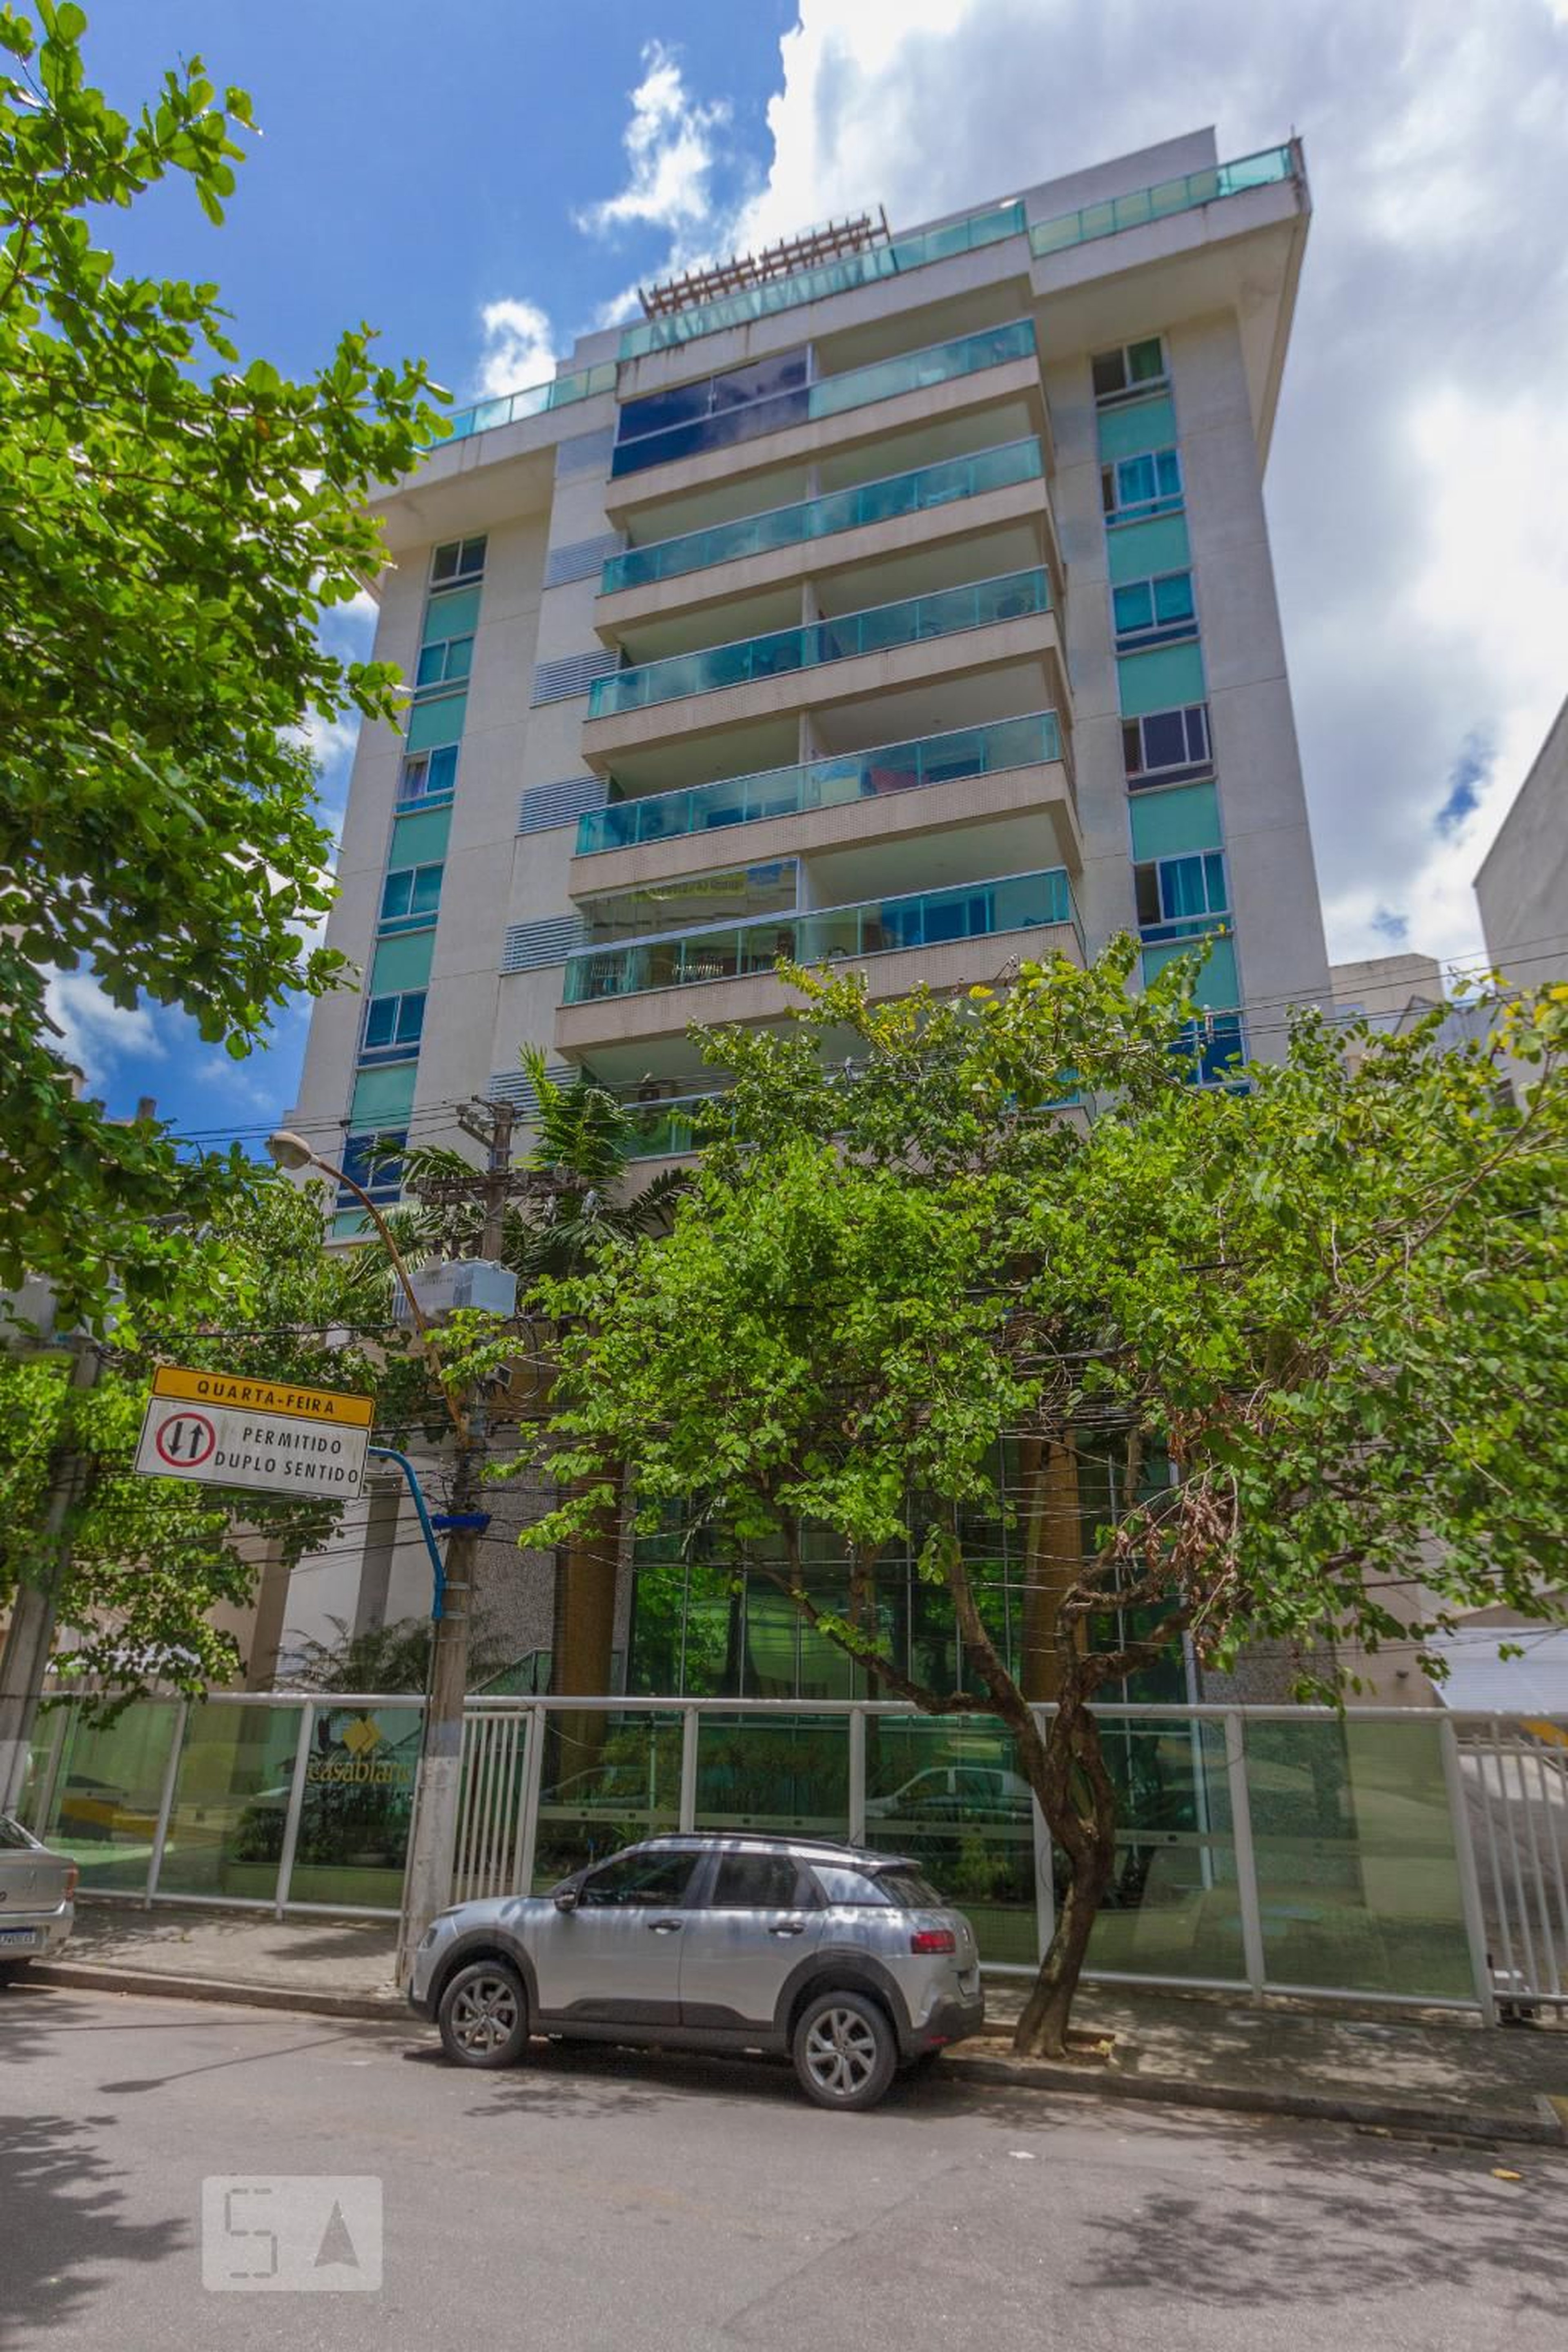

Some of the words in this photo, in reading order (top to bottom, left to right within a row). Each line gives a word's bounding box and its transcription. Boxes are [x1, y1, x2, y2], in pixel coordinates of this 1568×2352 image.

[197, 1380, 335, 1414] QUARTA-FEIRA
[242, 1427, 341, 1454] PERMITIDO
[214, 1450, 276, 1472] DUPLO
[284, 1459, 359, 1483] SENTIDO
